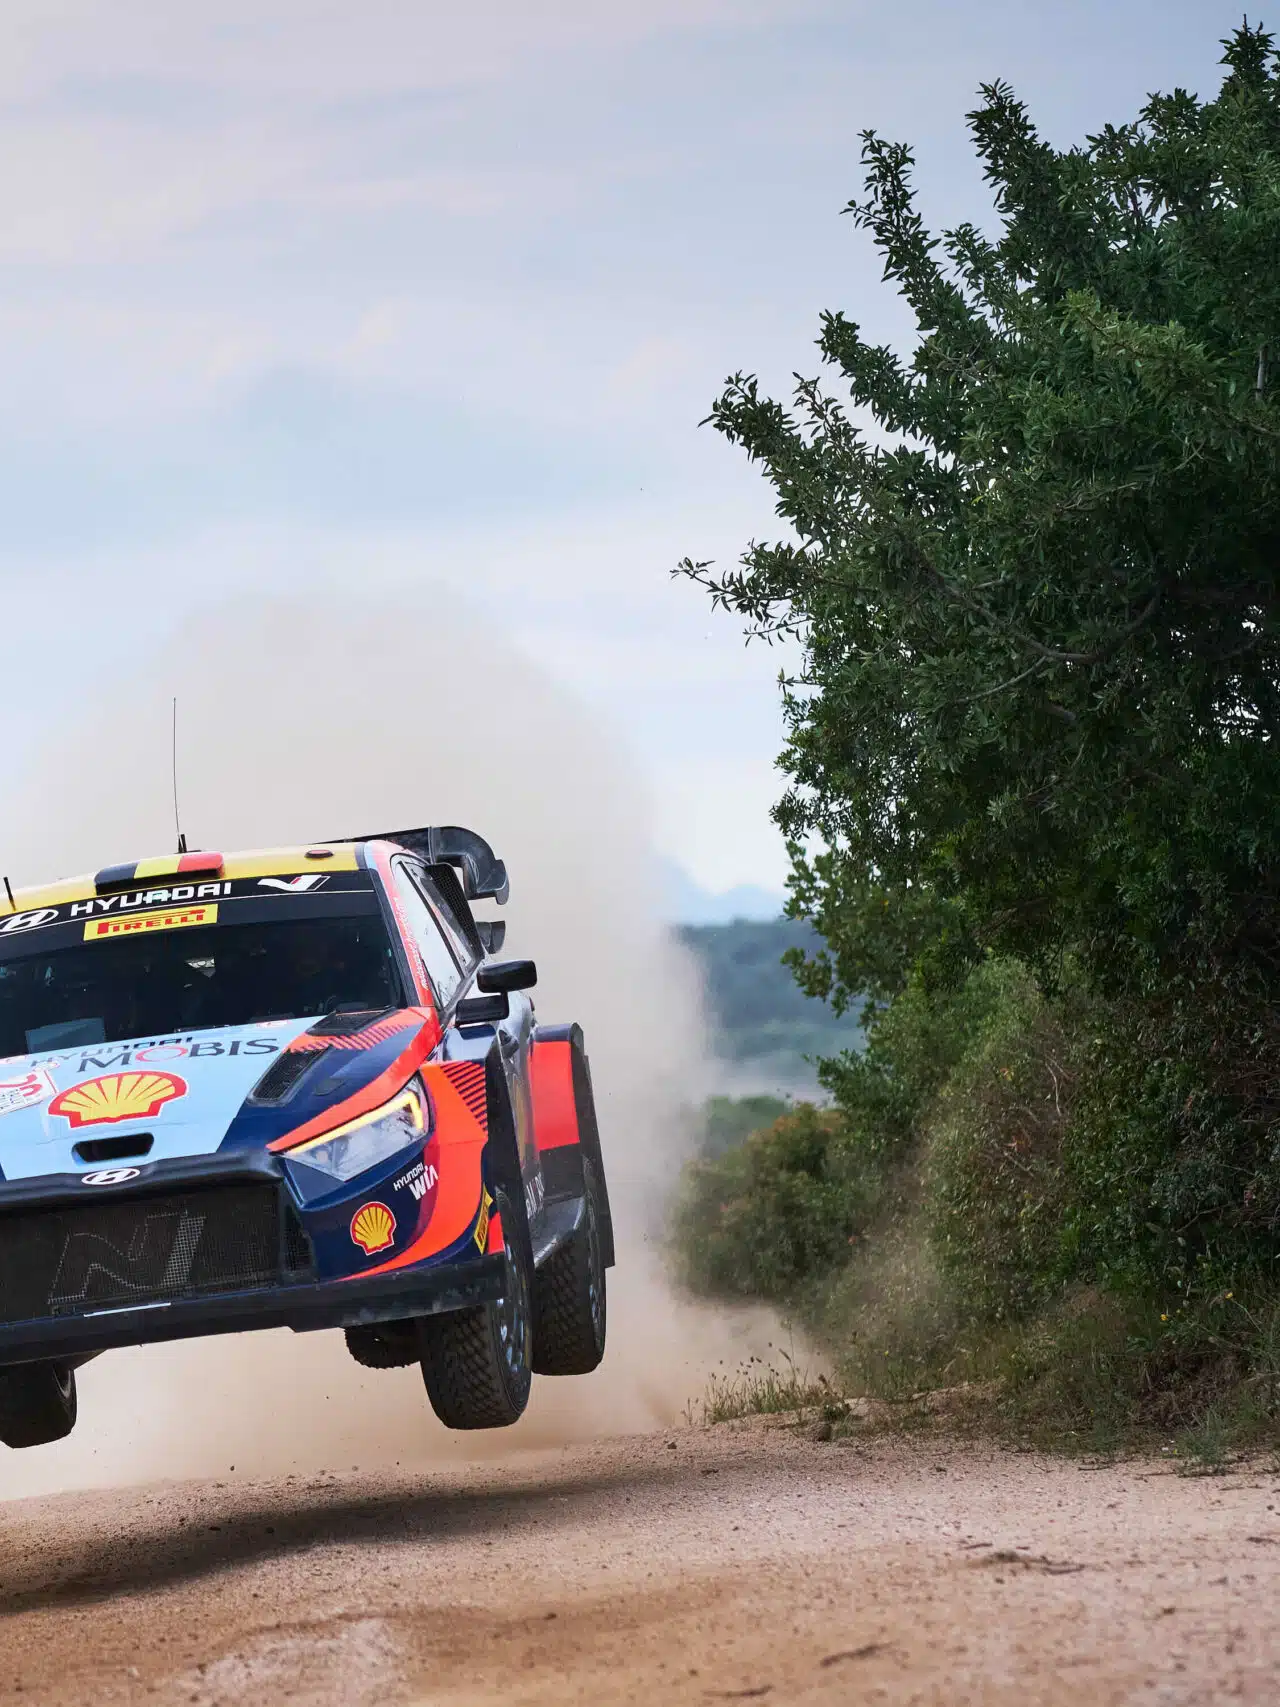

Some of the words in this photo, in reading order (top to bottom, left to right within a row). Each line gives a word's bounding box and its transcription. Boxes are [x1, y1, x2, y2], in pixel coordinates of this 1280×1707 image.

[97, 909, 206, 935] PIRELLI
[76, 1038, 281, 1073] MOBIS
[392, 1162, 424, 1191] HYUNDAI
